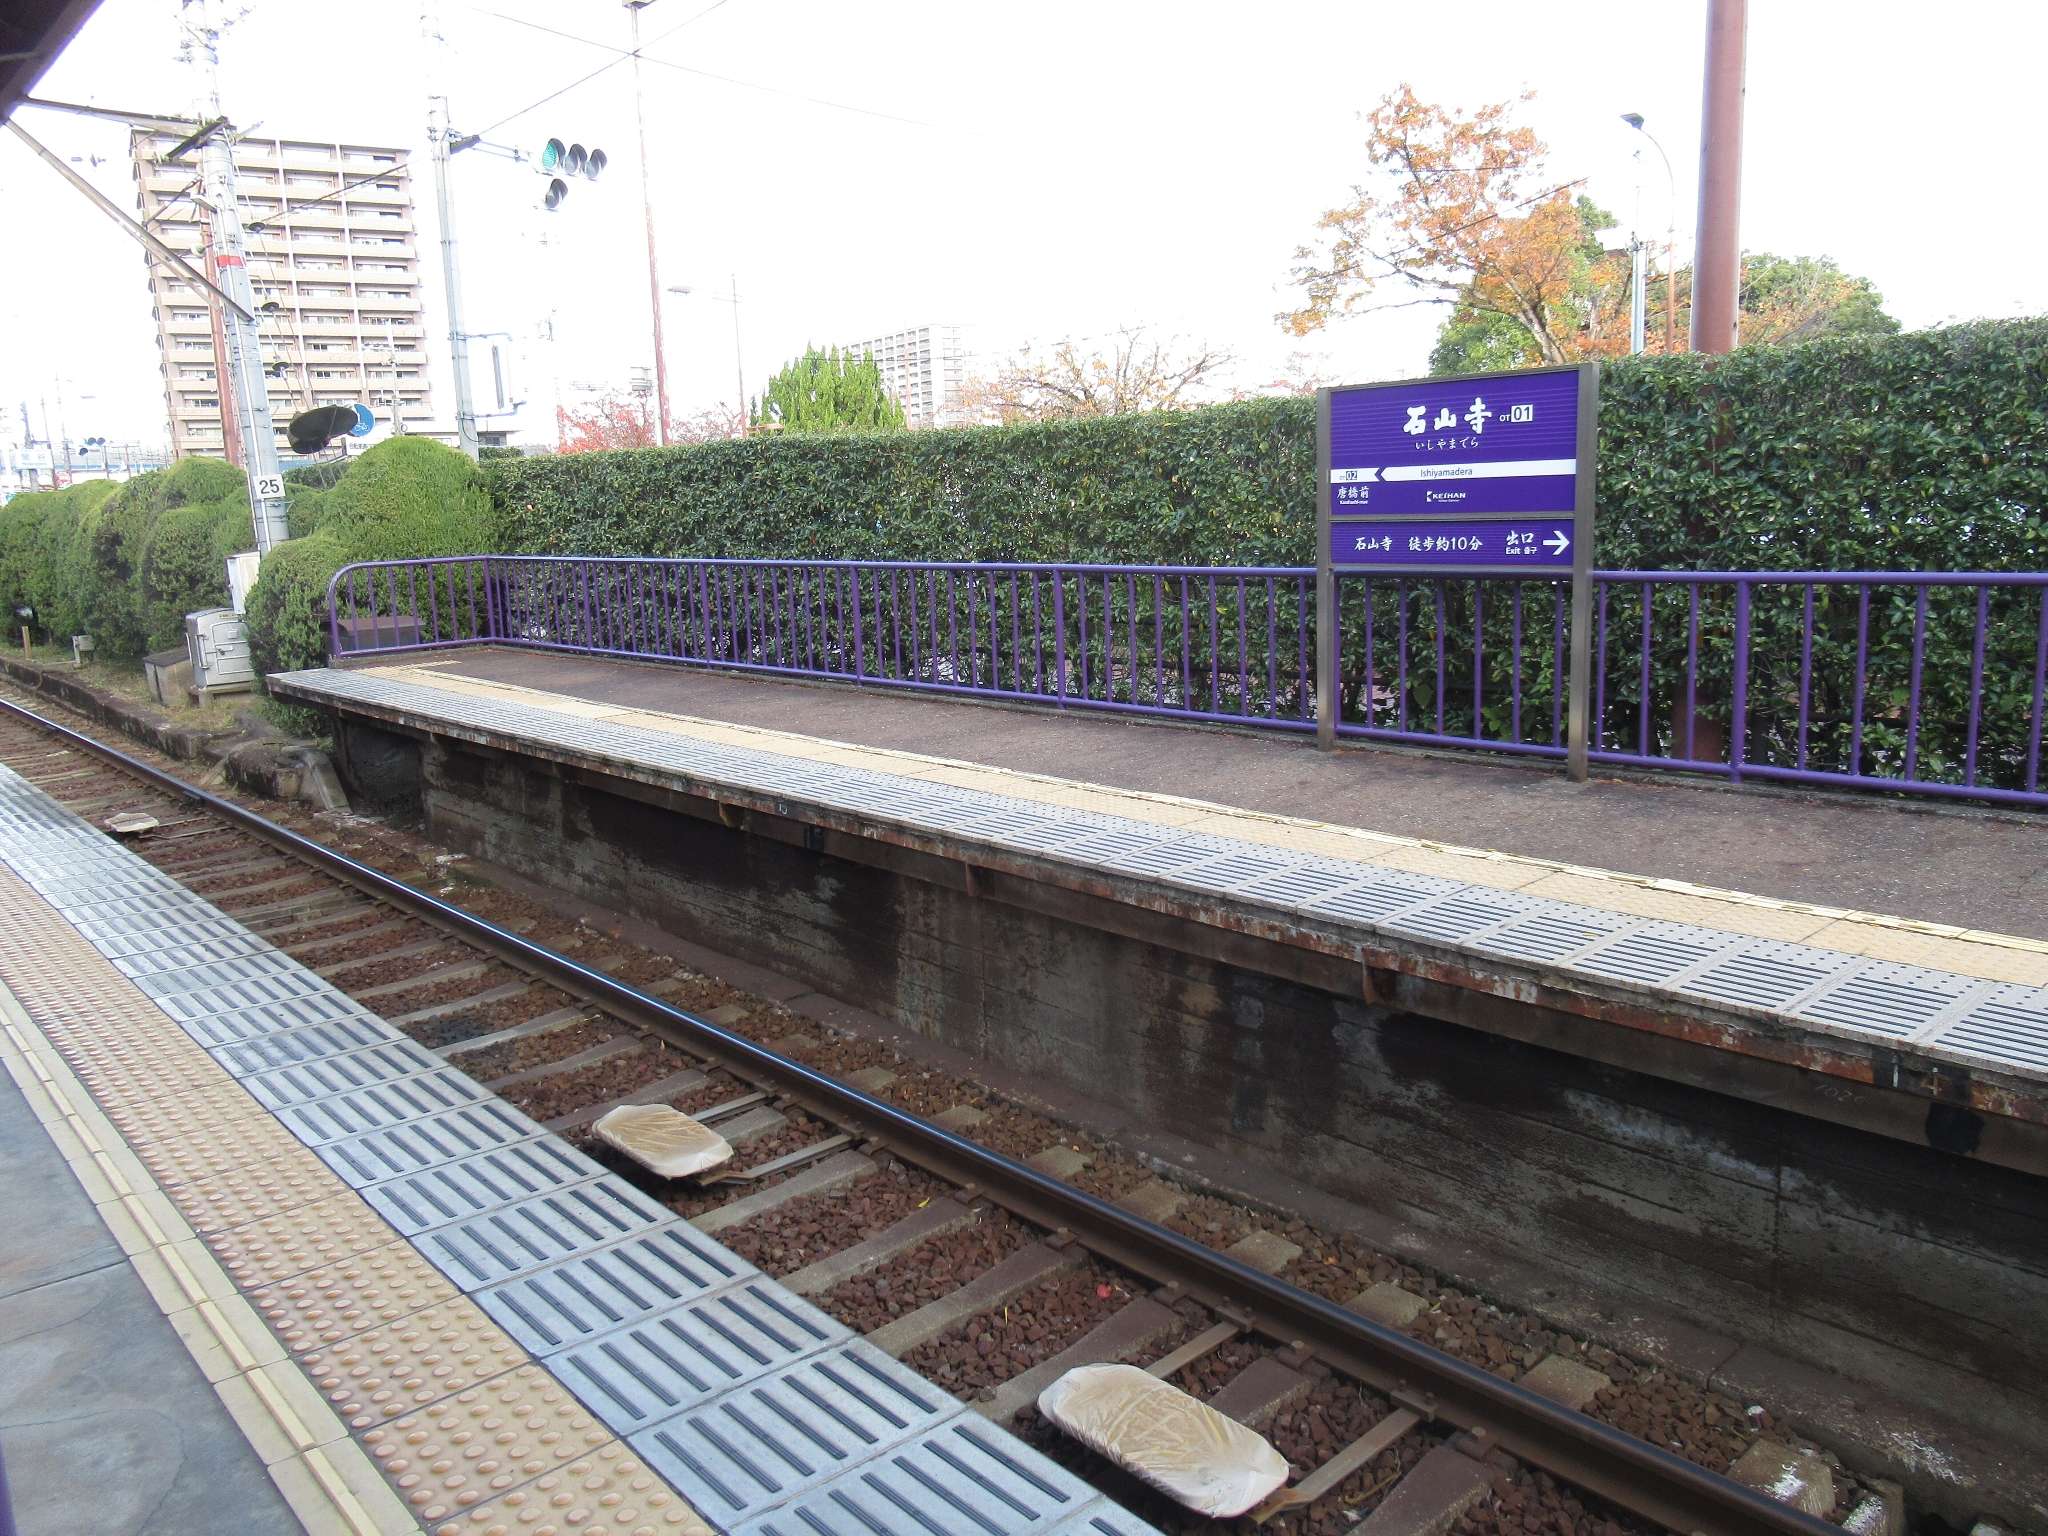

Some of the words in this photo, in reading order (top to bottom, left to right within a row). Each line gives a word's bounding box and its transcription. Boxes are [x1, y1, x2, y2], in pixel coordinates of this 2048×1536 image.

[1403, 397, 1492, 435] 石山寺
[1513, 406, 1530, 420] 01
[1415, 437, 1479, 450] いしやまでら
[1346, 471, 1357, 480] 02
[1420, 468, 1473, 478] Ishiyamadera
[259, 480, 280, 494] 25
[1337, 486, 1369, 499] 唐橋前
[1354, 536, 1393, 552] 石山寺
[1408, 536, 1483, 552] 徒歩約10分
[1506, 530, 1535, 546] 出口
[1505, 547, 1520, 555] Exit
